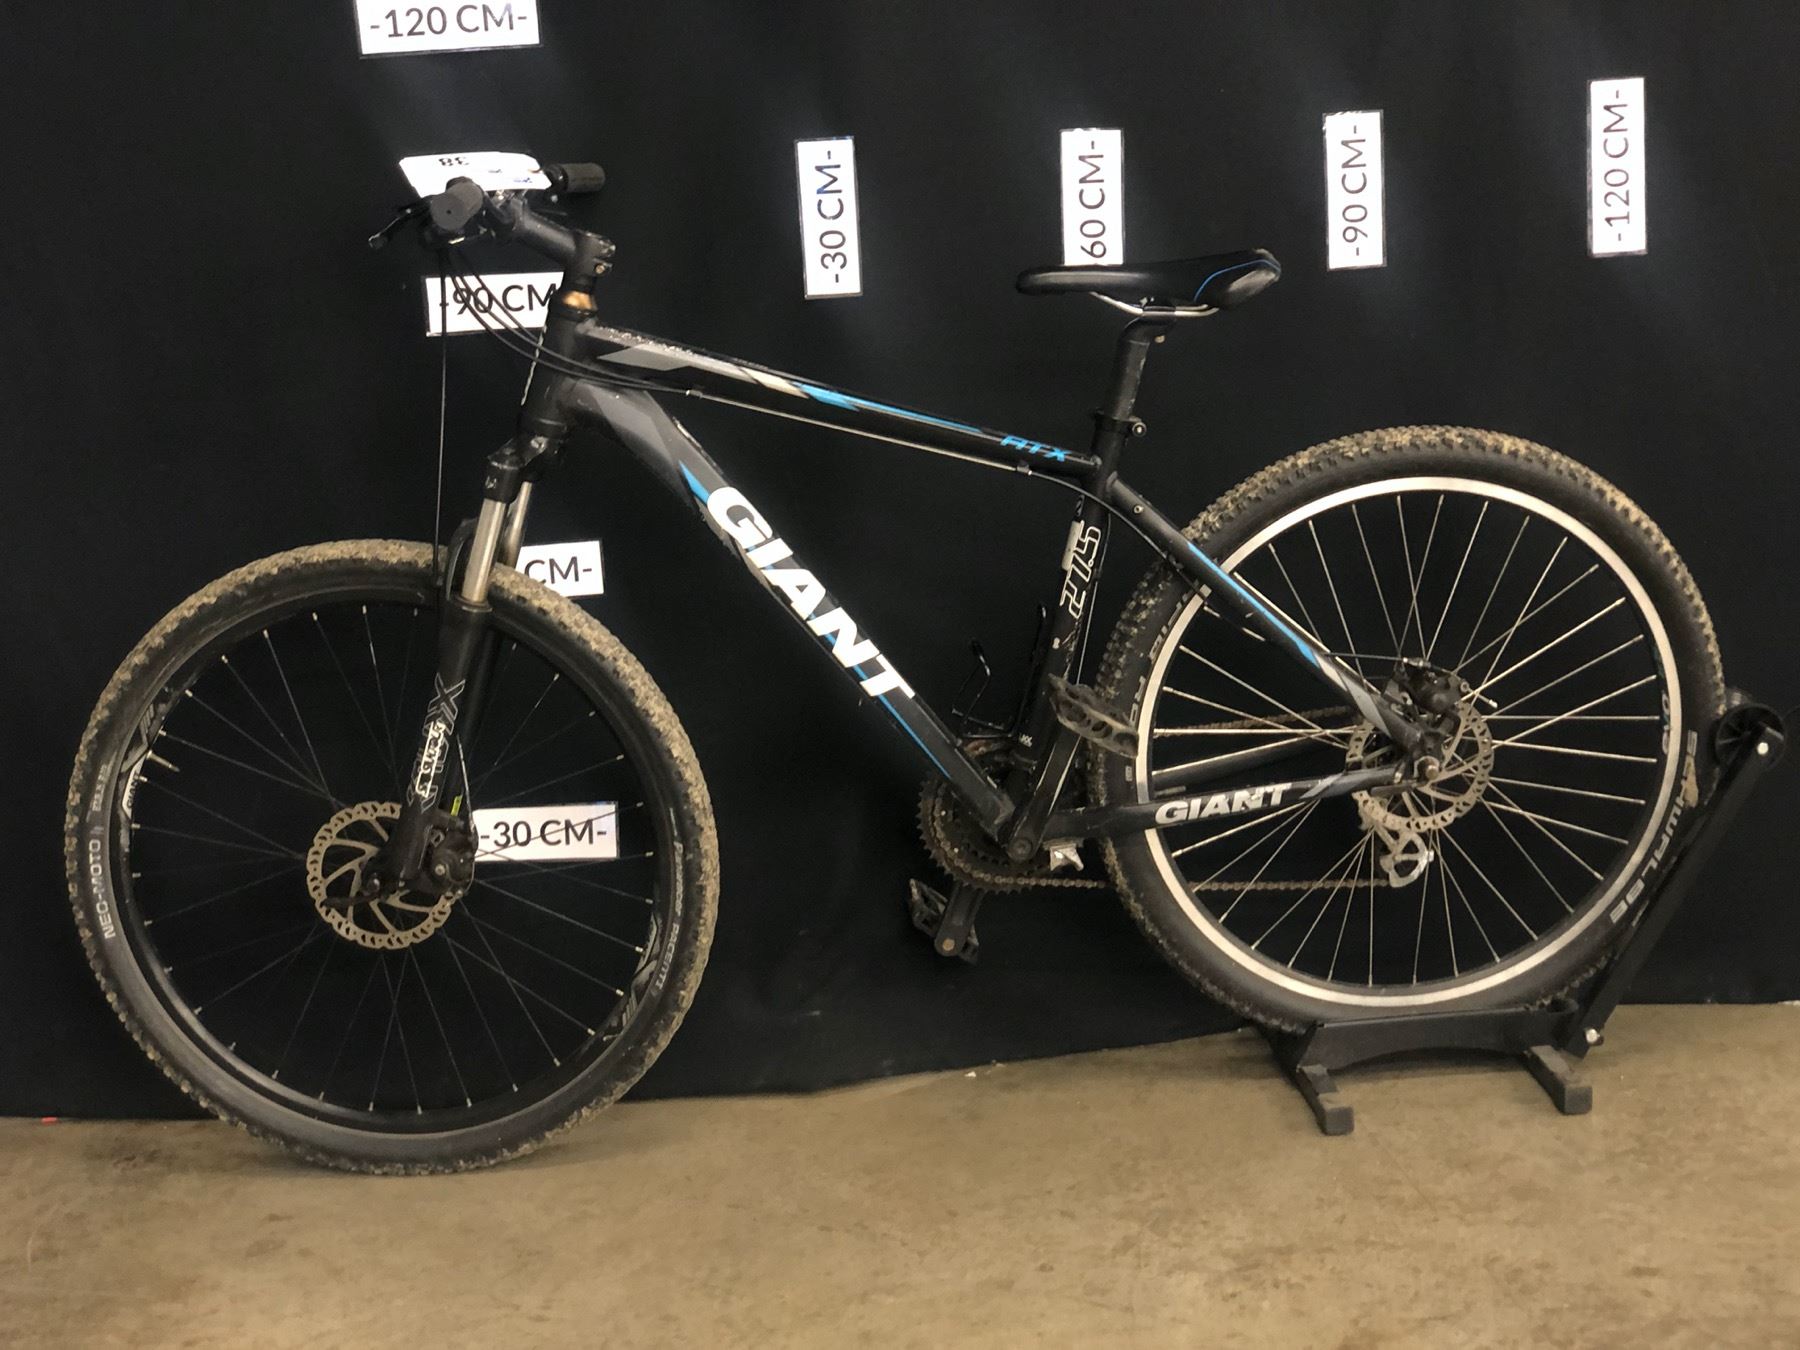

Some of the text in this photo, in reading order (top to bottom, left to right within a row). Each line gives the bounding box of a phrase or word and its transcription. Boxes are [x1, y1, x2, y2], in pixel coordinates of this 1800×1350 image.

[370, 3, 528, 38] -120 CM-
[1078, 140, 1108, 260] 60 CM-
[1340, 124, 1369, 257] -90 CM-
[1602, 89, 1631, 241] -120 CM-
[815, 149, 848, 284] -30 CM-
[439, 286, 493, 316] -90
[1001, 435, 1073, 463] ATX
[524, 556, 593, 585] CM-
[707, 486, 916, 700] GIANT
[480, 818, 607, 849] -30 CM-
[1155, 783, 1293, 825] GIANT
[89, 838, 116, 940] NEO-MOTO
